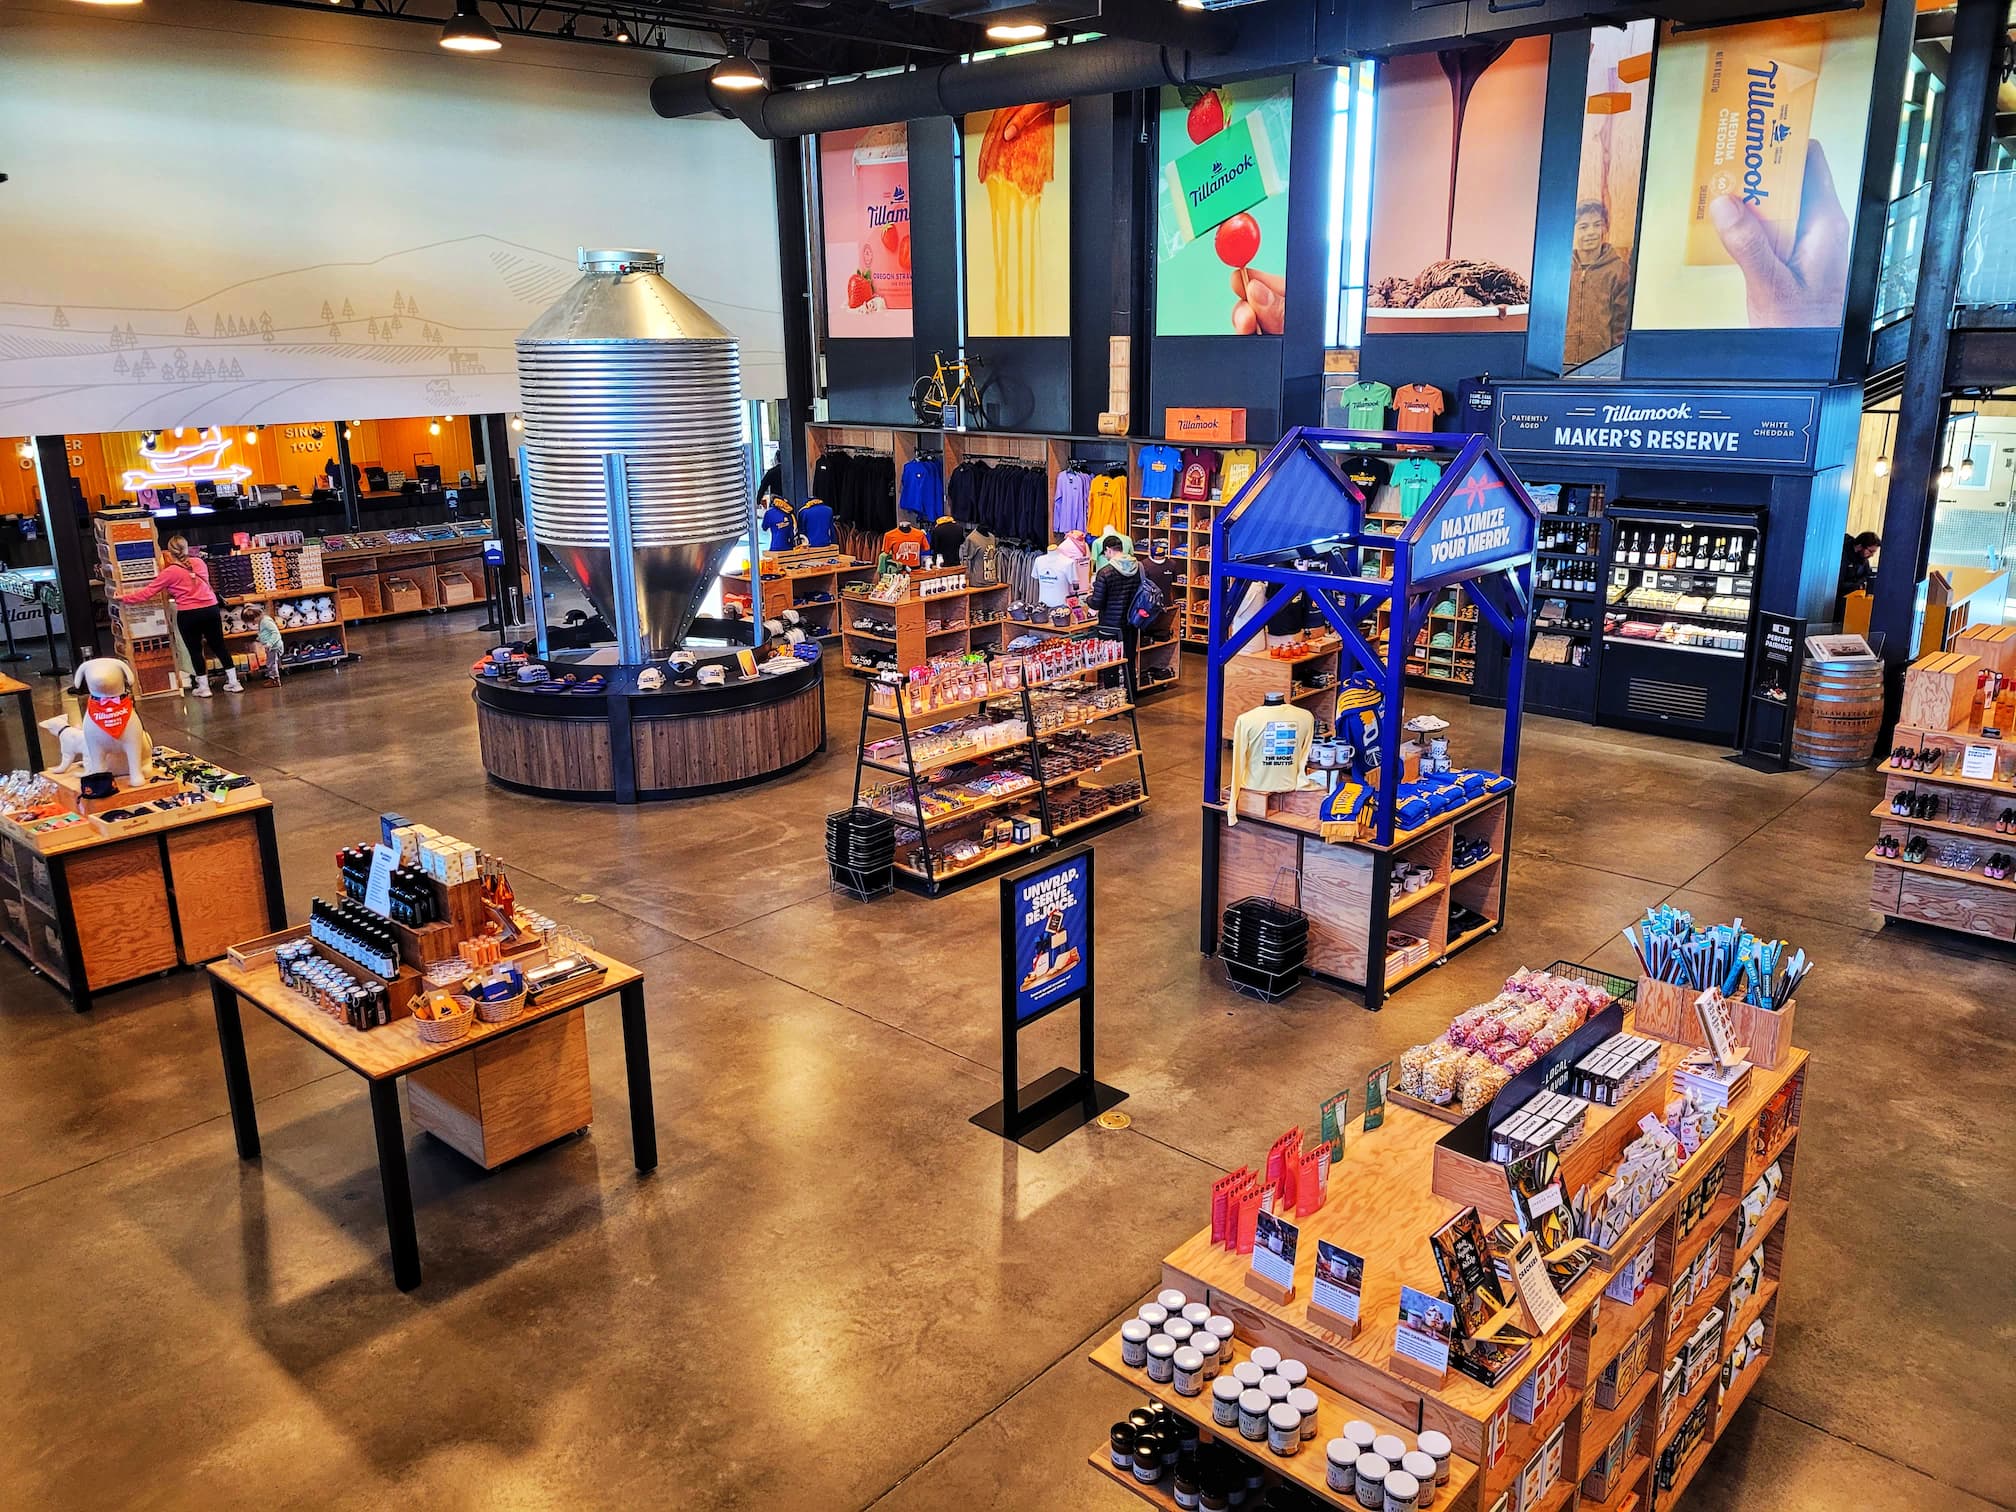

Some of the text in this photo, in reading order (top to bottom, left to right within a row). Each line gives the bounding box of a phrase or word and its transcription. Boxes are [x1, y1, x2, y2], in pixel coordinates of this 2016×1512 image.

[1713, 108, 1729, 166] CHEDDAR
[1725, 112, 1740, 161] MEDIUM
[1742, 60, 1779, 206] Tillamook
[1189, 153, 1253, 207] Tillamook
[1511, 414, 1549, 423] PATIENTLY
[1602, 402, 1692, 423] Tillamook
[1761, 420, 1789, 429] WHITE
[1178, 419, 1219, 431] Tillamook
[1519, 422, 1540, 430] AGED
[1753, 428, 1795, 438] CHEDDAR
[290, 440, 323, 453] 1909
[1646, 429, 1740, 452] RESERVE
[1441, 507, 1505, 540] MAXIMIZE
[1430, 526, 1511, 565] YOUR MERRY.
[1765, 640, 1793, 653] PAIRINGS
[1766, 633, 1793, 646] PERFECT
[1022, 867, 1079, 901] UNWRAP.
[1031, 884, 1071, 911] SERVE.
[1025, 894, 1078, 927] REJOICE.
[1518, 1255, 1539, 1280] CRACKERS
